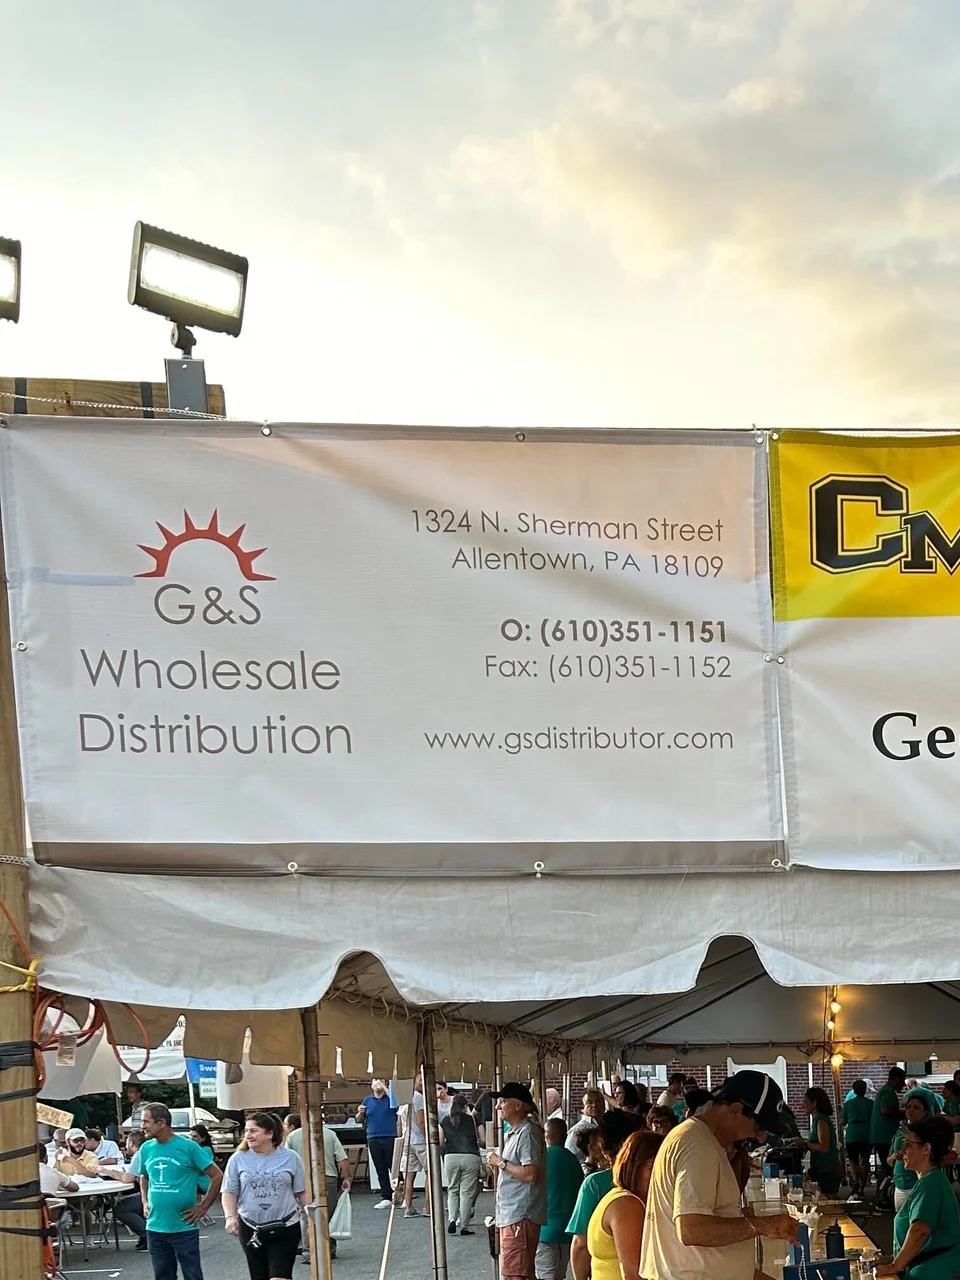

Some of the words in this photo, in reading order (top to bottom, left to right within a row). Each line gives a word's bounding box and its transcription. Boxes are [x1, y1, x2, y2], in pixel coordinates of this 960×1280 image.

[410, 509, 471, 534] 1324
[481, 511, 511, 535] N.
[517, 511, 638, 541] Sherman
[647, 516, 724, 542] Street
[451, 547, 594, 573] Allentown,
[604, 550, 641, 572] PA
[651, 553, 724, 578] 18109
[153, 584, 263, 626] G&S
[499, 619, 532, 643] O:
[540, 619, 728, 648] (610)351-1151
[80, 649, 341, 691] Wholesale
[485, 655, 539, 679] Fax:
[549, 656, 732, 682] (610)351-1152
[79, 714, 353, 756] Distribution
[424, 726, 734, 754] www.gsdistributor.com
